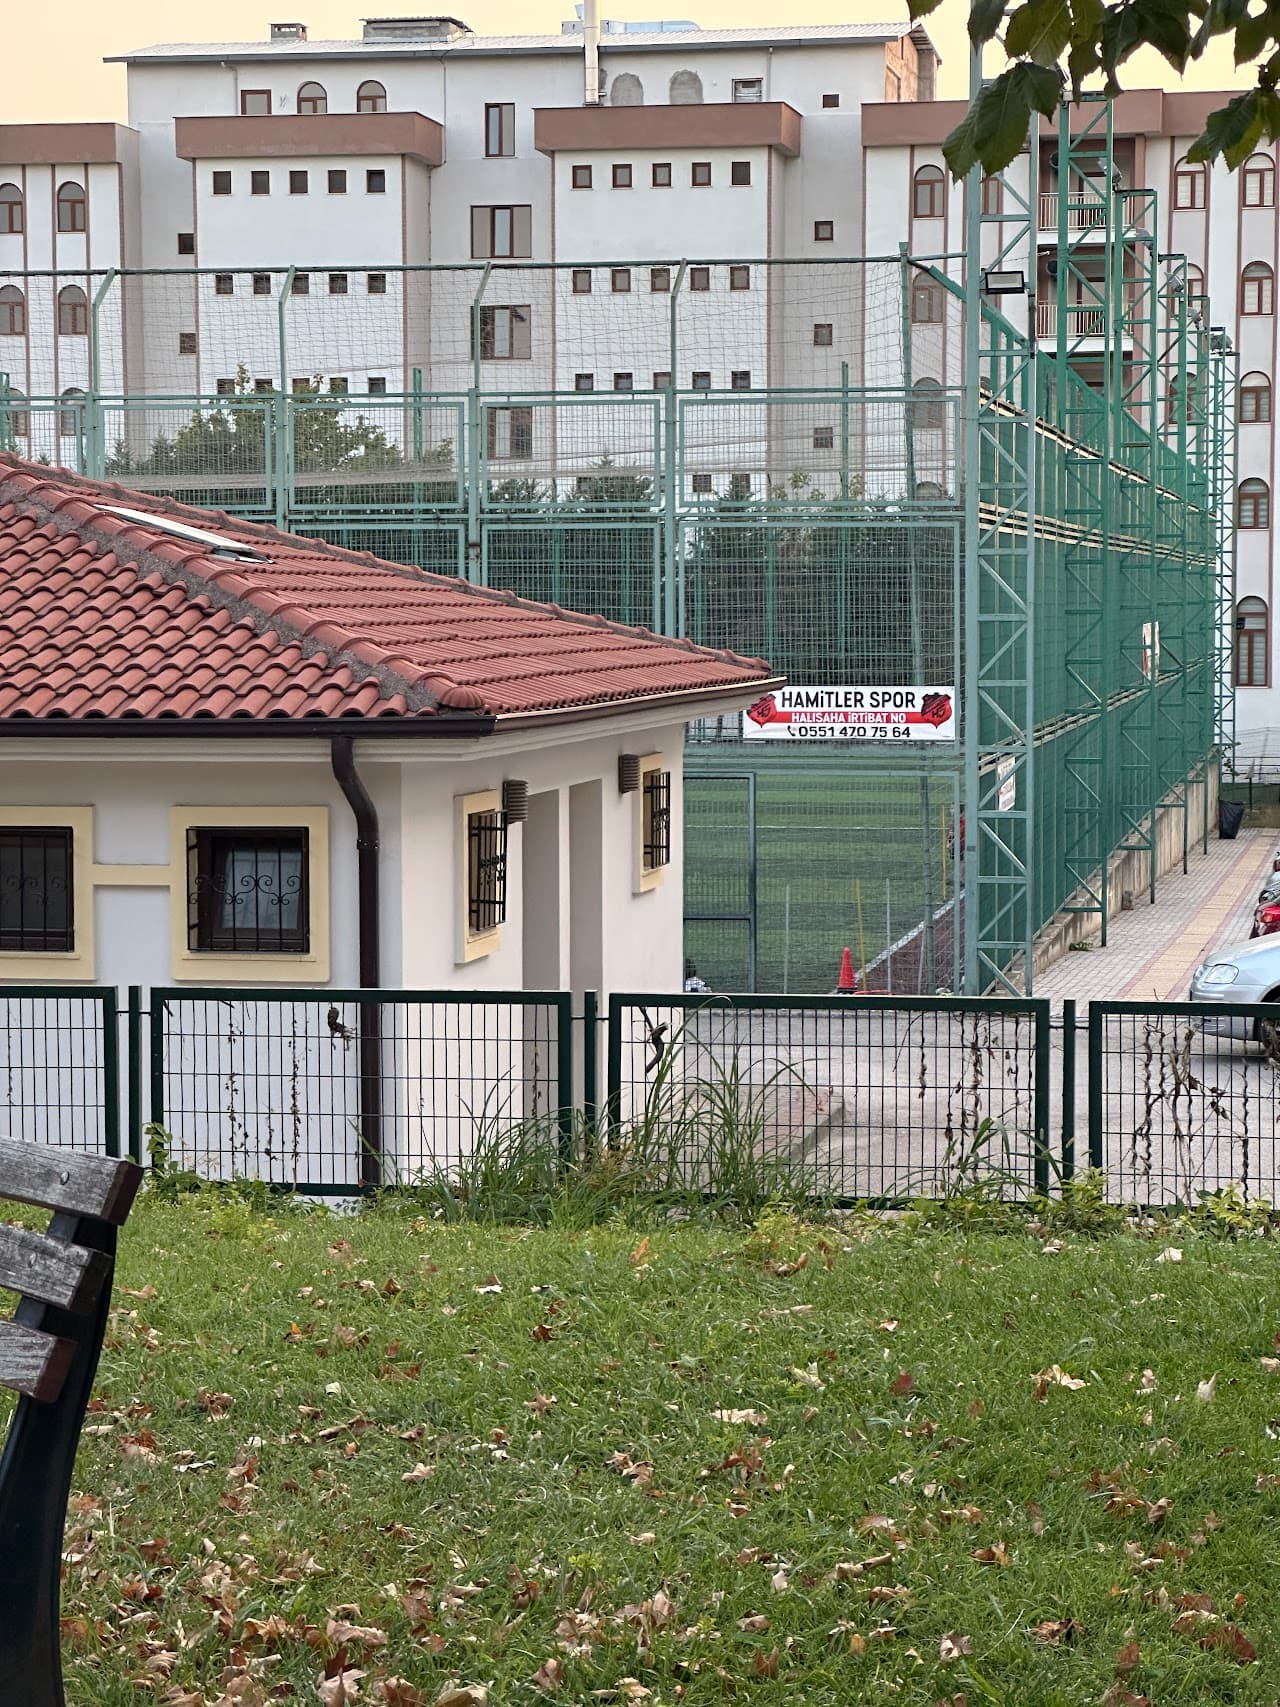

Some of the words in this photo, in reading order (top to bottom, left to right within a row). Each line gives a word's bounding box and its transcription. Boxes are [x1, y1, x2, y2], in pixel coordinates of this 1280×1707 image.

[869, 691, 916, 708] SPOR
[791, 712, 845, 723] HALISAHA
[890, 713, 906, 723] NO
[798, 726, 835, 737] 0551
[839, 726, 867, 737] 470
[871, 726, 887, 737] 75
[892, 726, 911, 737] 64
